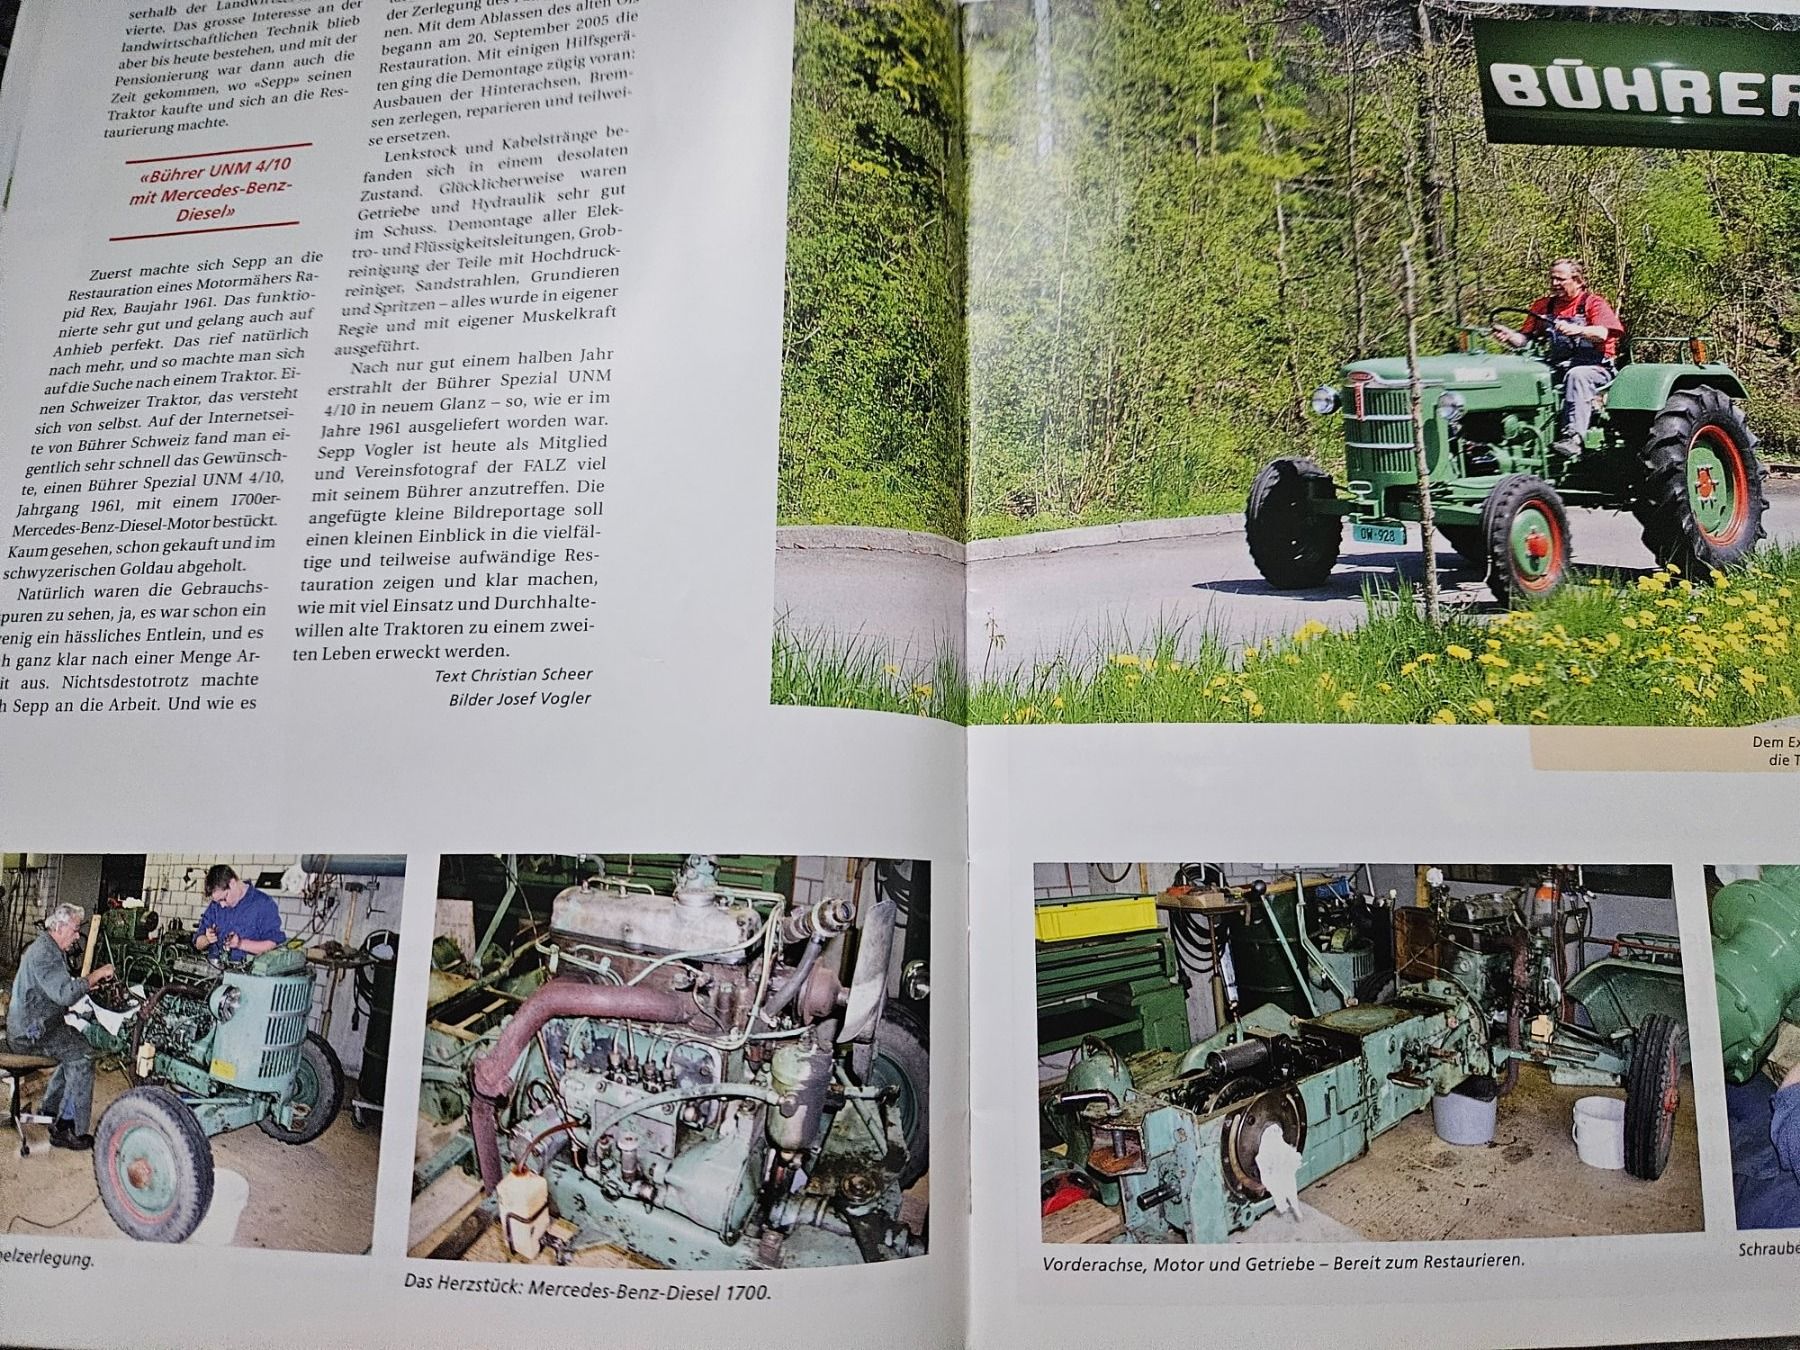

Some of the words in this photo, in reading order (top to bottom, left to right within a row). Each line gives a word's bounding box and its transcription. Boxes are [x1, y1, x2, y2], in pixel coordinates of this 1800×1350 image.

[121, 30, 258, 53] landwirtschaftlichen
[266, 20, 318, 37] Technik
[327, 15, 360, 29] blieb
[115, 69, 209, 87] Pensionierung
[217, 66, 242, 76] war
[250, 61, 284, 73] dann
[293, 53, 325, 68] auch
[334, 50, 355, 62] die
[110, 92, 136, 104] Zeit
[143, 85, 219, 104] gekommen,
[228, 82, 247, 91] wo
[254, 76, 300, 89] «Sepp»
[307, 70, 352, 83] seinen
[104, 124, 175, 138] taurierung
[177, 117, 229, 132] machte.
[368, 137, 383, 146] se
[386, 130, 450, 144] ersetzen.
[140, 167, 206, 183] «Bührer
[209, 161, 253, 178] UNM
[255, 157, 292, 173] 4/10
[129, 190, 158, 206] mit
[160, 181, 293, 203] Mercedes-Benz-
[360, 185, 423, 202] Zustand.
[439, 172, 564, 195] Glücklicherweise
[580, 165, 626, 179] waren
[176, 204, 235, 222] Diesel»
[68, 284, 153, 301] Restauration
[156, 281, 193, 293] eines
[196, 273, 292, 290] Motormähers
[296, 271, 319, 282] Ra-
[345, 283, 405, 298] reiniger,
[415, 273, 519, 292] Sandstrahlen,
[531, 266, 619, 283] Grundieren
[338, 322, 378, 338] Regie
[386, 318, 416, 332] und
[424, 316, 449, 330] mit
[458, 315, 515, 330] eigener
[522, 304, 616, 323] Muskelkraft
[52, 342, 103, 358] Anhieb
[110, 338, 164, 356] perfekt.
[173, 336, 200, 348] Das
[208, 331, 236, 345] rief
[242, 327, 309, 343] natürlich
[327, 380, 392, 396] erstrahlt
[402, 379, 427, 392] der
[436, 375, 491, 390] Bührer
[500, 370, 557, 390] Spezial
[569, 368, 611, 383] UNM
[39, 405, 65, 415] nen
[70, 398, 141, 413] Schweizer
[146, 394, 201, 408] Traktor,
[208, 390, 234, 404] das
[239, 386, 298, 401] versteht
[321, 424, 361, 439] Jahre
[369, 422, 400, 435] 1961
[408, 417, 500, 436] ausgeliefert
[507, 414, 566, 429] worden
[574, 416, 608, 426] war.
[317, 446, 355, 462] Sepp
[365, 442, 414, 460] Vogler
[423, 441, 441, 454] ist
[452, 439, 496, 453] heute
[506, 437, 529, 451] als
[539, 434, 607, 453] Mitglied
[315, 466, 345, 480] und
[355, 460, 478, 479] Vereinsfotograf
[487, 459, 514, 474] der
[524, 458, 566, 472] FALZ
[577, 456, 606, 470] viel
[21, 485, 37, 497] te,
[43, 481, 82, 494] einen
[88, 478, 139, 492] Bührer
[143, 474, 197, 492] Spezial
[203, 472, 243, 486] UNM
[248, 470, 284, 484] 4/10,
[312, 488, 338, 502] mit
[343, 487, 399, 501] seinem
[407, 484, 463, 499] Bührer
[469, 480, 569, 497] anzutreffen.
[577, 479, 605, 493] Die
[16, 503, 80, 519] Jahrgang
[91, 499, 124, 513] 1961,
[136, 497, 162, 510] mit
[172, 495, 218, 509] einem
[231, 492, 281, 506] 1700er-
[308, 509, 386, 528] angefügte
[395, 507, 444, 521] kleine
[453, 504, 565, 522] Bildreportage
[574, 501, 603, 516] soll
[12, 517, 211, 538] Mercedes-Benz-Diesel-Motor
[212, 513, 278, 528] bestückt.
[306, 533, 349, 547] einen
[354, 530, 413, 545] kleinen
[418, 527, 486, 543] Einblick
[490, 527, 507, 541] in
[512, 526, 538, 540] die
[543, 524, 601, 539] vielfäl-
[2, 563, 116, 582] schwyzerischen
[120, 561, 174, 575] Goldau
[177, 558, 246, 577] abgeholt.
[303, 555, 332, 573] tige
[340, 553, 371, 568] und
[380, 552, 451, 567] teilweise
[459, 548, 556, 567] aufwändige
[564, 548, 599, 562] Res-
[17, 585, 85, 601] Natürlich
[94, 587, 139, 598] waren
[148, 582, 172, 597] die
[181, 579, 269, 596] Gebrauchs-
[301, 576, 373, 592] tauration
[382, 575, 434, 593] zeigen
[444, 573, 476, 588] und
[485, 572, 519, 587] klar
[527, 570, 598, 587] machen,
[295, 623, 343, 637] willen
[349, 622, 379, 637] alte
[383, 621, 464, 636] Traktoren
[468, 623, 488, 634] zu
[493, 619, 545, 634] einem
[550, 617, 595, 633] zwei-
[293, 649, 317, 661] ten
[322, 645, 371, 661] Leben
[375, 644, 441, 660] erweckt
[444, 643, 510, 658] werden.
[435, 670, 467, 683] Text
[471, 668, 537, 682] Christian
[541, 667, 594, 681] Scheer
[449, 692, 494, 707] Bilder
[496, 691, 538, 706] Josef
[541, 691, 592, 708] Vogler
[1753, 736, 1784, 748] Dem
[1769, 753, 1790, 766] die
[0, 1247, 94, 1271] elzerlegung.
[1043, 1256, 1147, 1274] Vorderachse,
[1153, 1257, 1205, 1272] Motor
[1209, 1256, 1241, 1272] und
[1245, 1256, 1315, 1272] Getriebe
[1333, 1255, 1382, 1271] Bereit
[1385, 1258, 1418, 1270] zum
[1423, 1252, 1525, 1269] Restaurieren.
[404, 1272, 434, 1289] Das
[437, 1274, 524, 1295] Herzstück:
[528, 1280, 721, 1301] Mercedes-Benz-Diesel
[727, 1285, 771, 1301] 1700.
